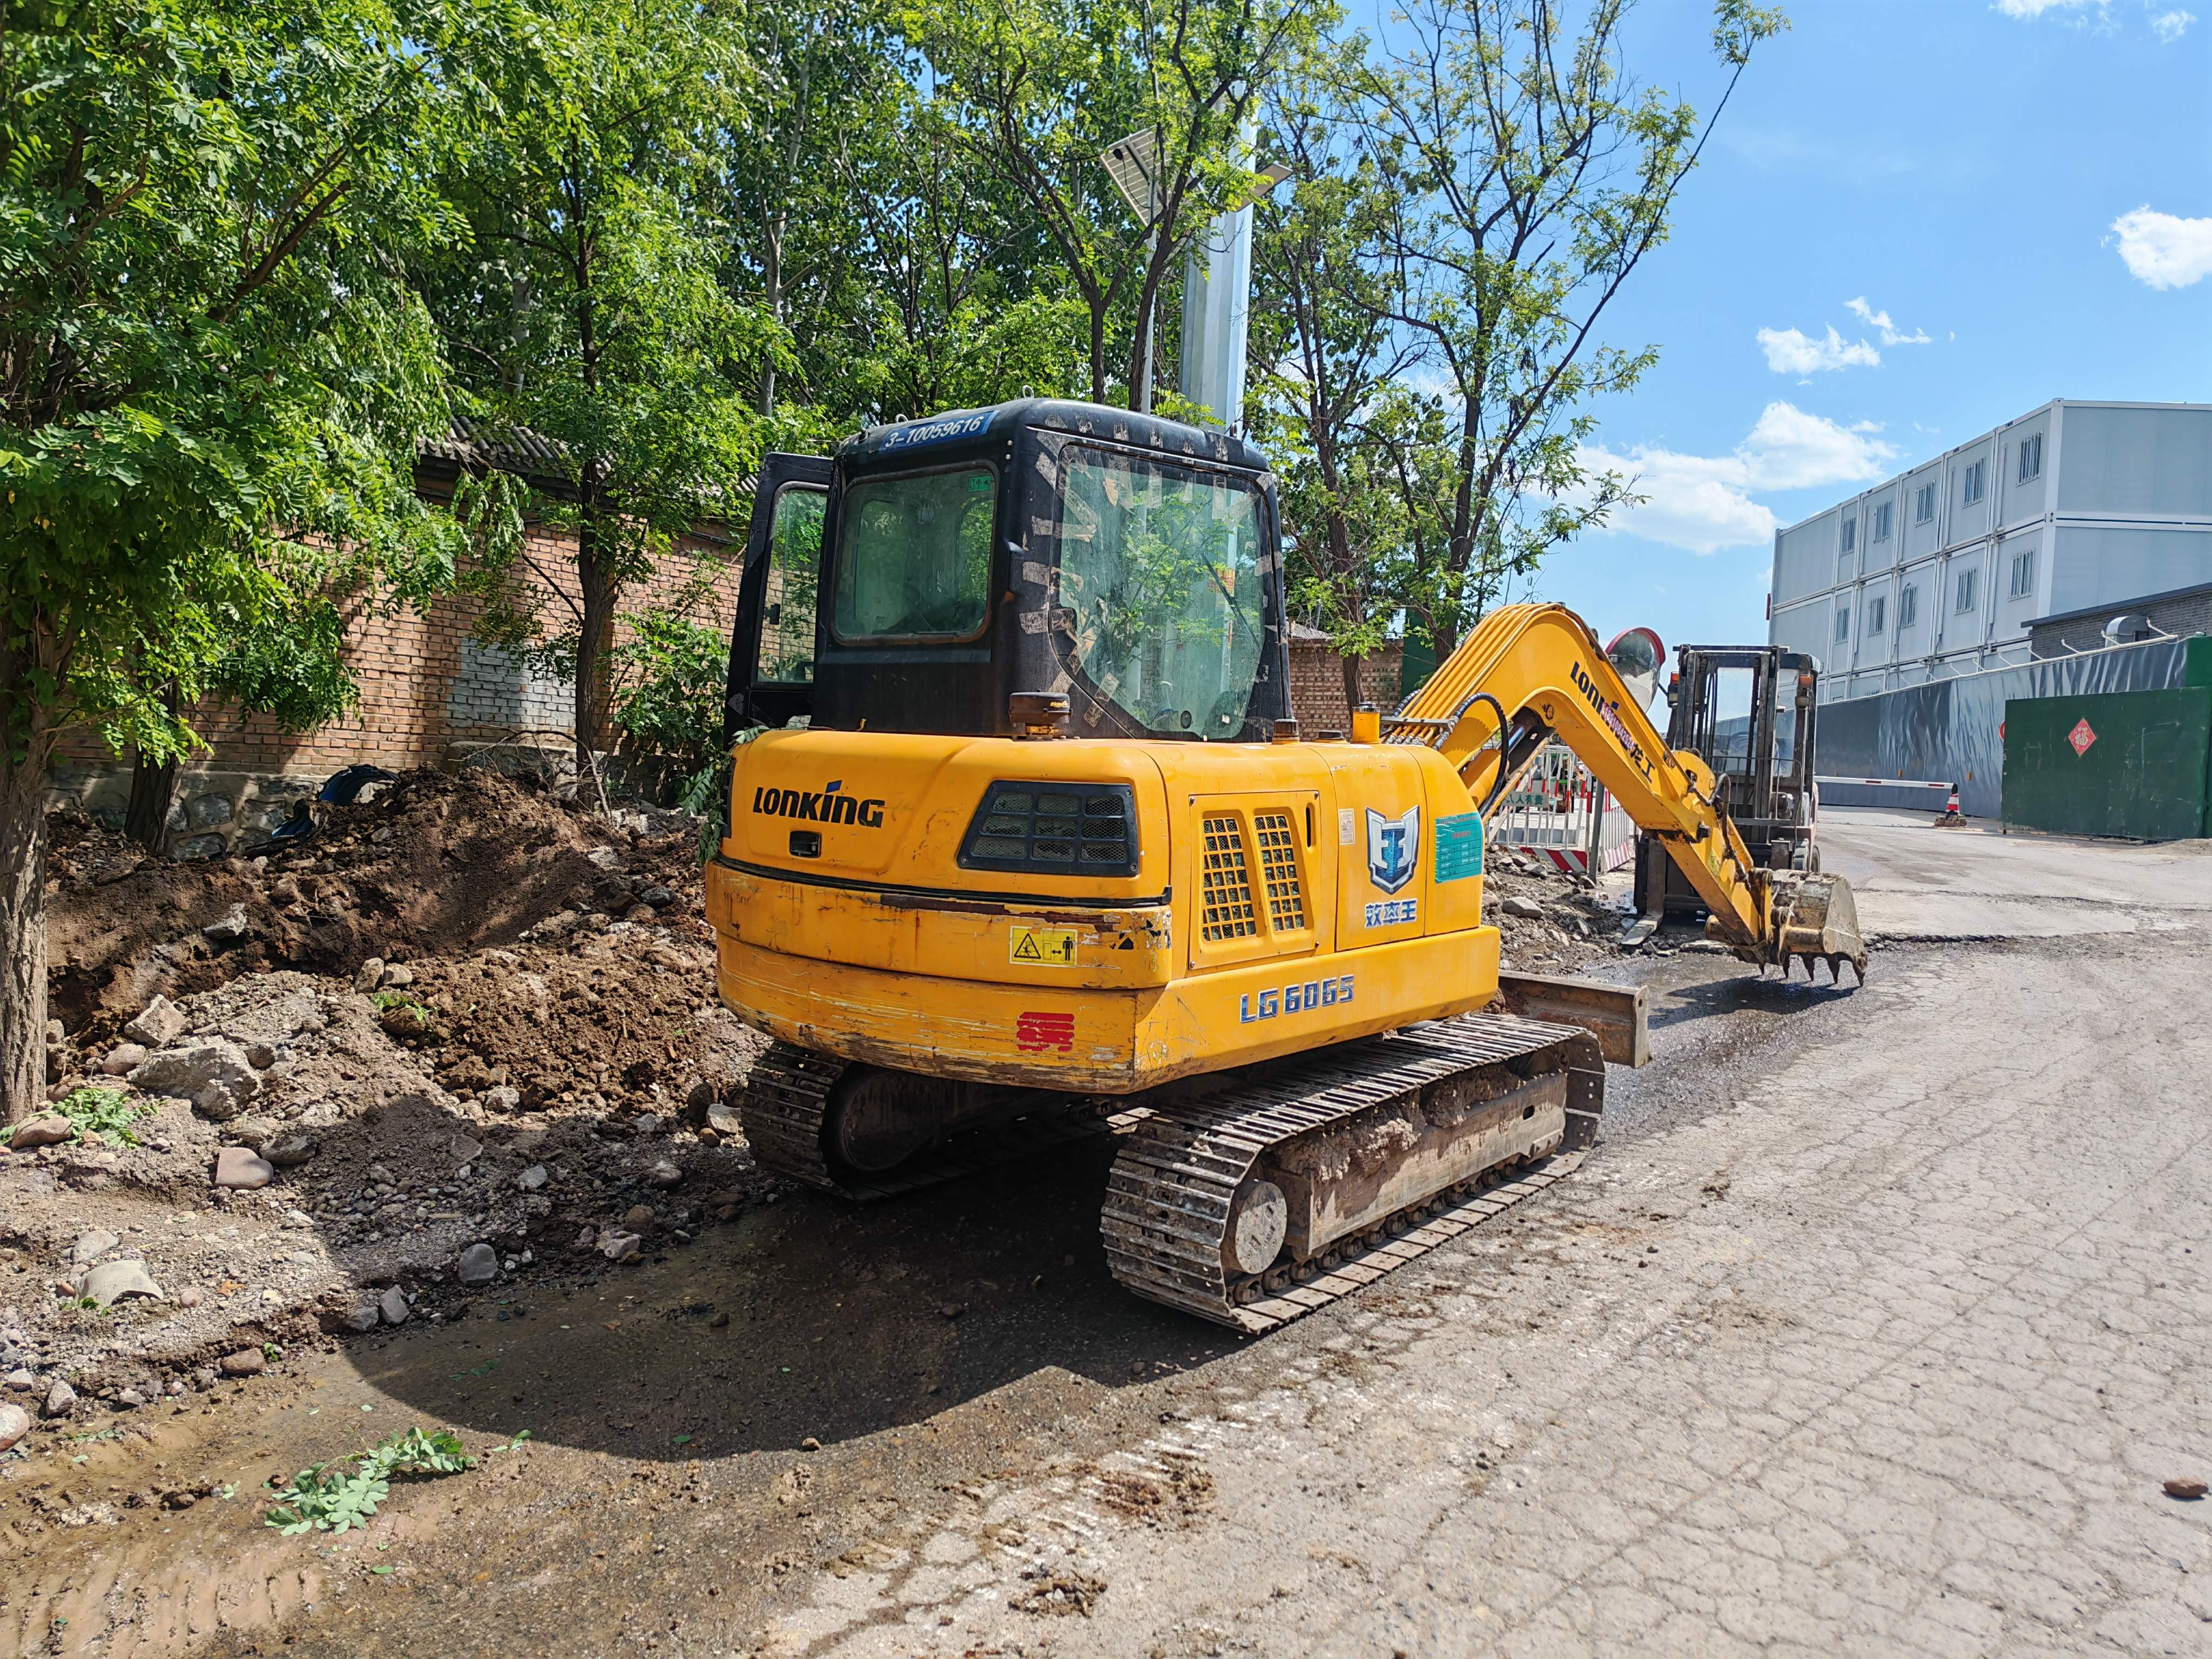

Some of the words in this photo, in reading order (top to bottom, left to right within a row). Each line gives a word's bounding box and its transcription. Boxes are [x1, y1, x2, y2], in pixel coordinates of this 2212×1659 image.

[885, 416, 984, 448] 3-10059616
[2075, 727, 2089, 746] 福
[1365, 899, 1418, 928] 效率王
[1283, 974, 1354, 1014] 6065
